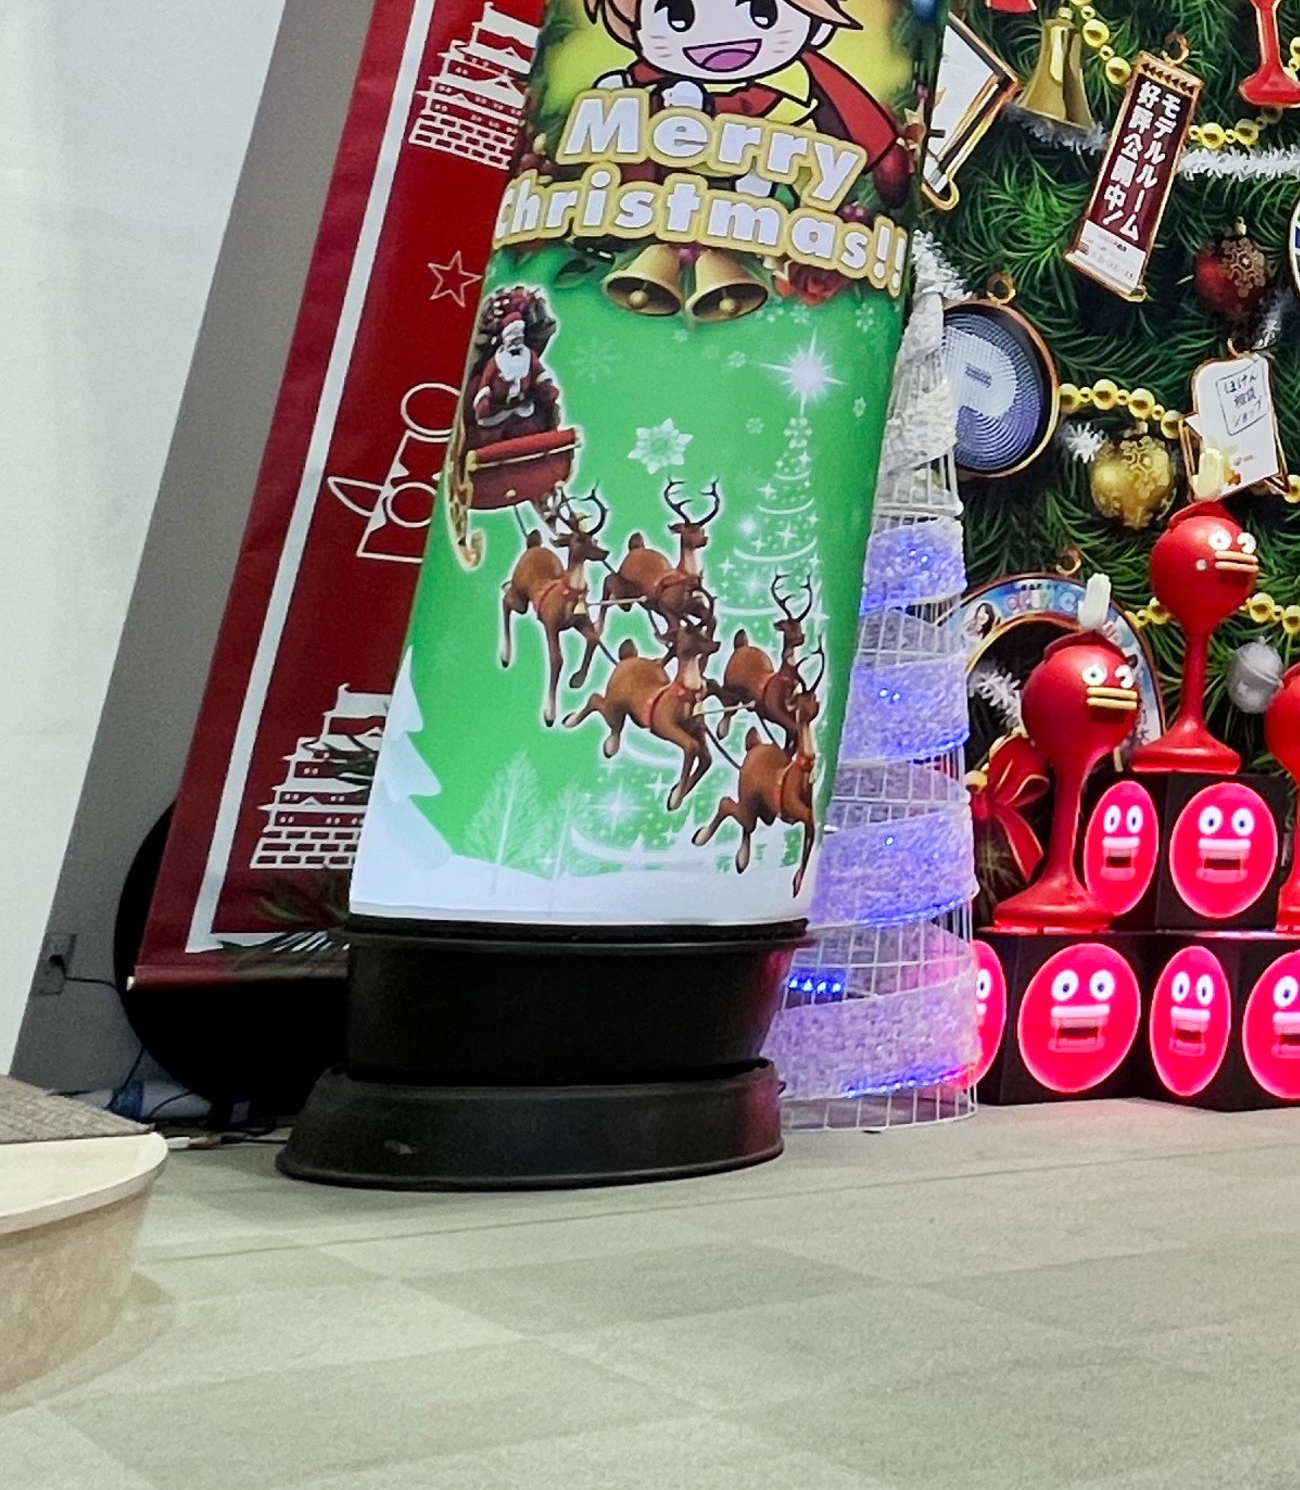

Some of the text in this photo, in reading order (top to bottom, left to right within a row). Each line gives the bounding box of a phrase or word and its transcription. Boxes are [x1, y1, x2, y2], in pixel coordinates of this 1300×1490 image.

[560, 94, 861, 204] Merry
[1119, 93, 1181, 241] モデルルーム
